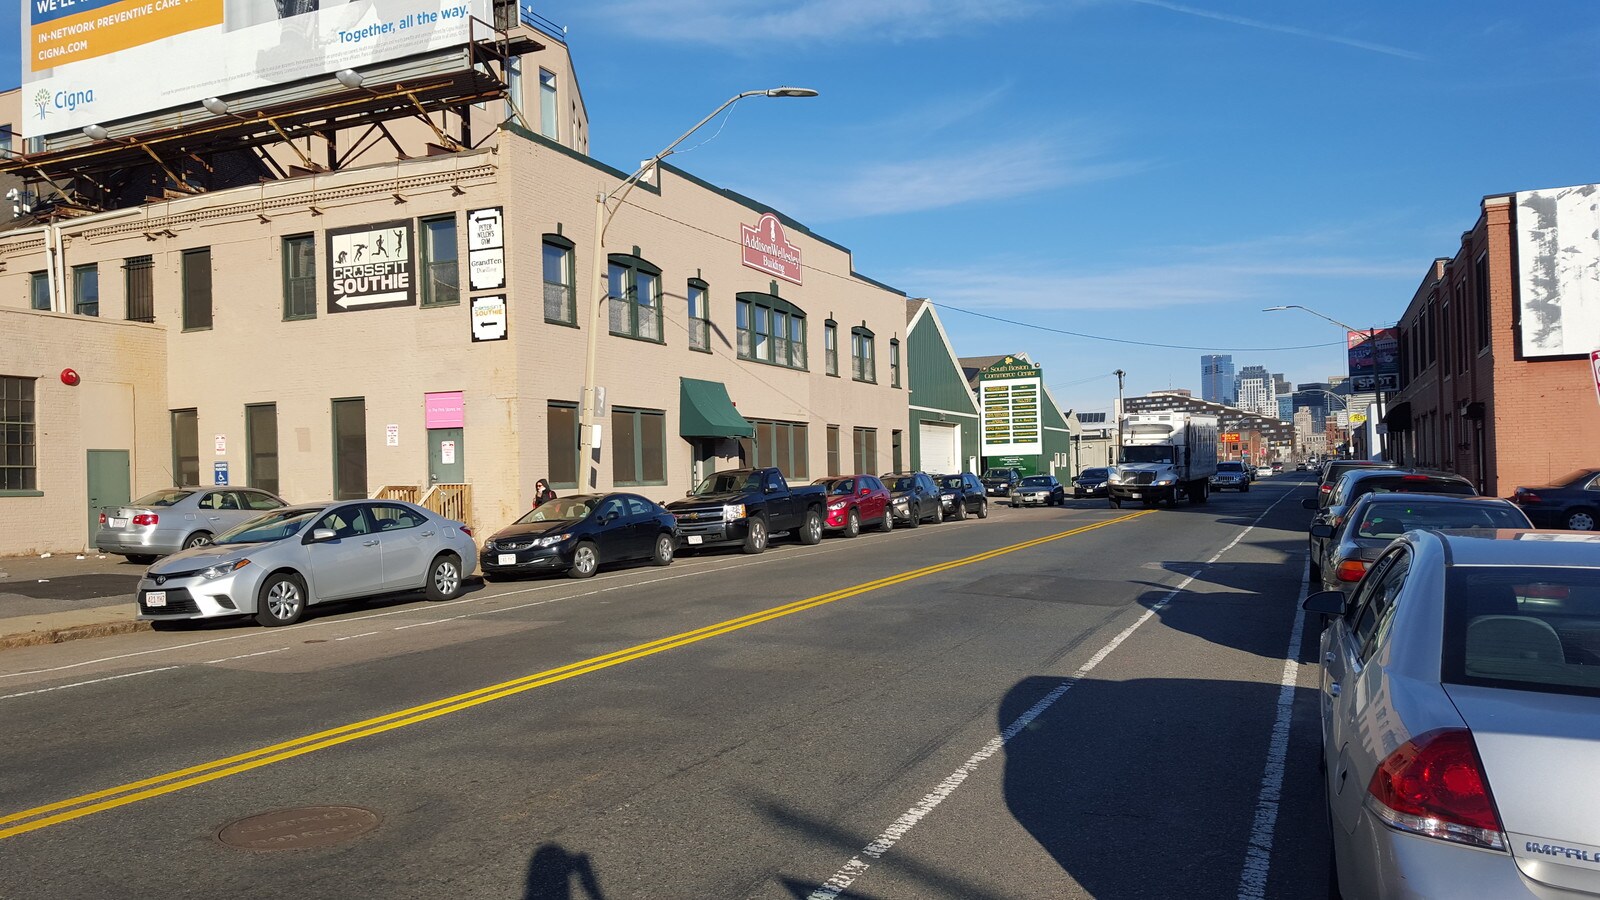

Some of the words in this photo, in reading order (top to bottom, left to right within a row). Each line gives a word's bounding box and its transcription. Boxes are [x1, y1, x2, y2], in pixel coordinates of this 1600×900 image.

[38, 20, 95, 43] IN-NETWORK
[97, 4, 153, 28] PREVENTIVE
[155, 0, 181, 11] CARE
[339, 21, 396, 43] Together,
[399, 15, 414, 29] all
[417, 11, 437, 25] the
[441, 5, 469, 20] way.
[38, 40, 88, 60] CIGNA.COM
[55, 89, 94, 111] Cigna
[478, 223, 493, 231] PETER
[333, 260, 408, 280] CROSSFIT
[471, 258, 502, 267] GrandTen
[763, 255, 785, 274] Building
[333, 272, 409, 295] SOUTHIE
[990, 365, 1007, 373] South
